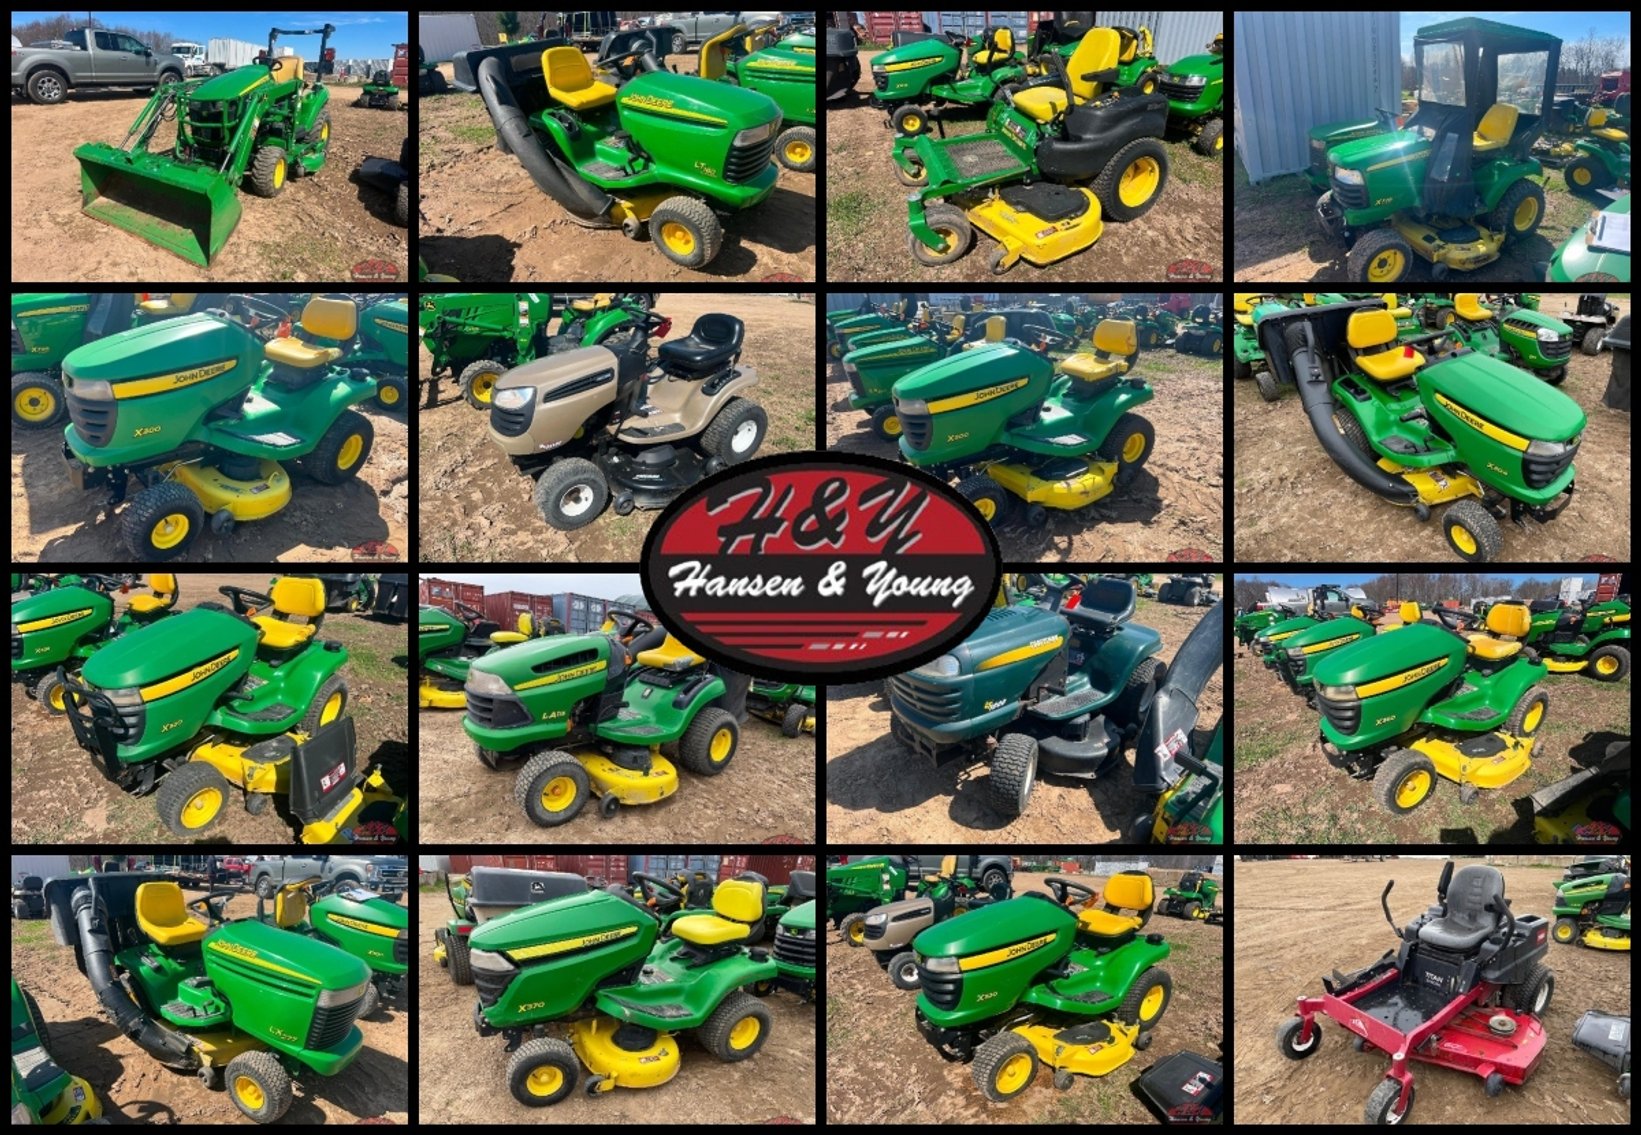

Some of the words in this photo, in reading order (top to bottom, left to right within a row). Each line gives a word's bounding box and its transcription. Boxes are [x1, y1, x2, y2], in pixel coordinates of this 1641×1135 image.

[173, 369, 199, 384] JOHN
[199, 362, 226, 378] DEERE
[1445, 400, 1461, 417] JOHN
[1461, 411, 1484, 430] DEERE
[192, 664, 211, 682] JOHN
[211, 656, 231, 673] DEERE
[1007, 944, 1027, 957] JOHN
[1027, 938, 1047, 951] DEERE
[1425, 970, 1444, 983] TITAN
